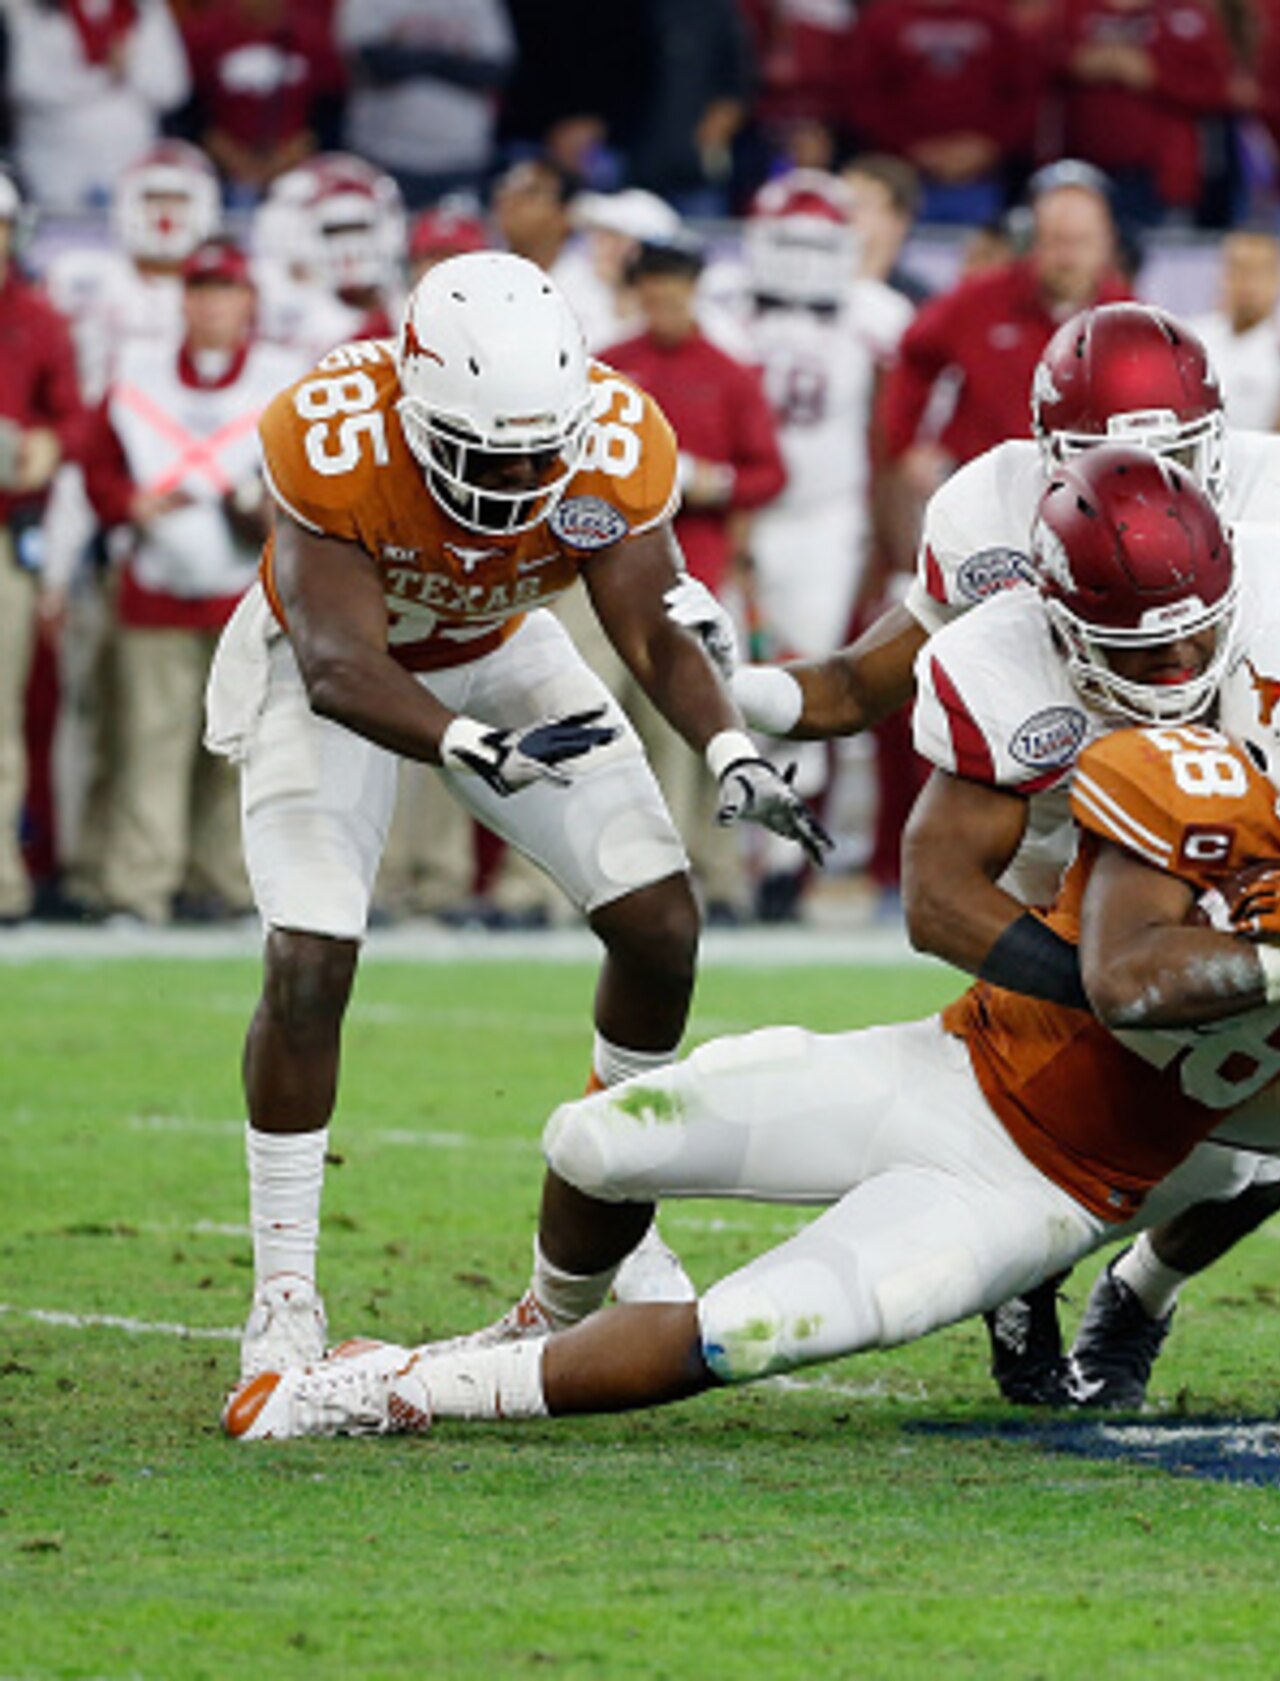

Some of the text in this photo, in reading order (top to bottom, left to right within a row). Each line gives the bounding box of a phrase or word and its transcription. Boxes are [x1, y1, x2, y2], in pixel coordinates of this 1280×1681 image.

[294, 370, 389, 476] 85
[387, 568, 541, 613] TEXAS
[1138, 726, 1249, 799] 28
[1184, 834, 1229, 860] C
